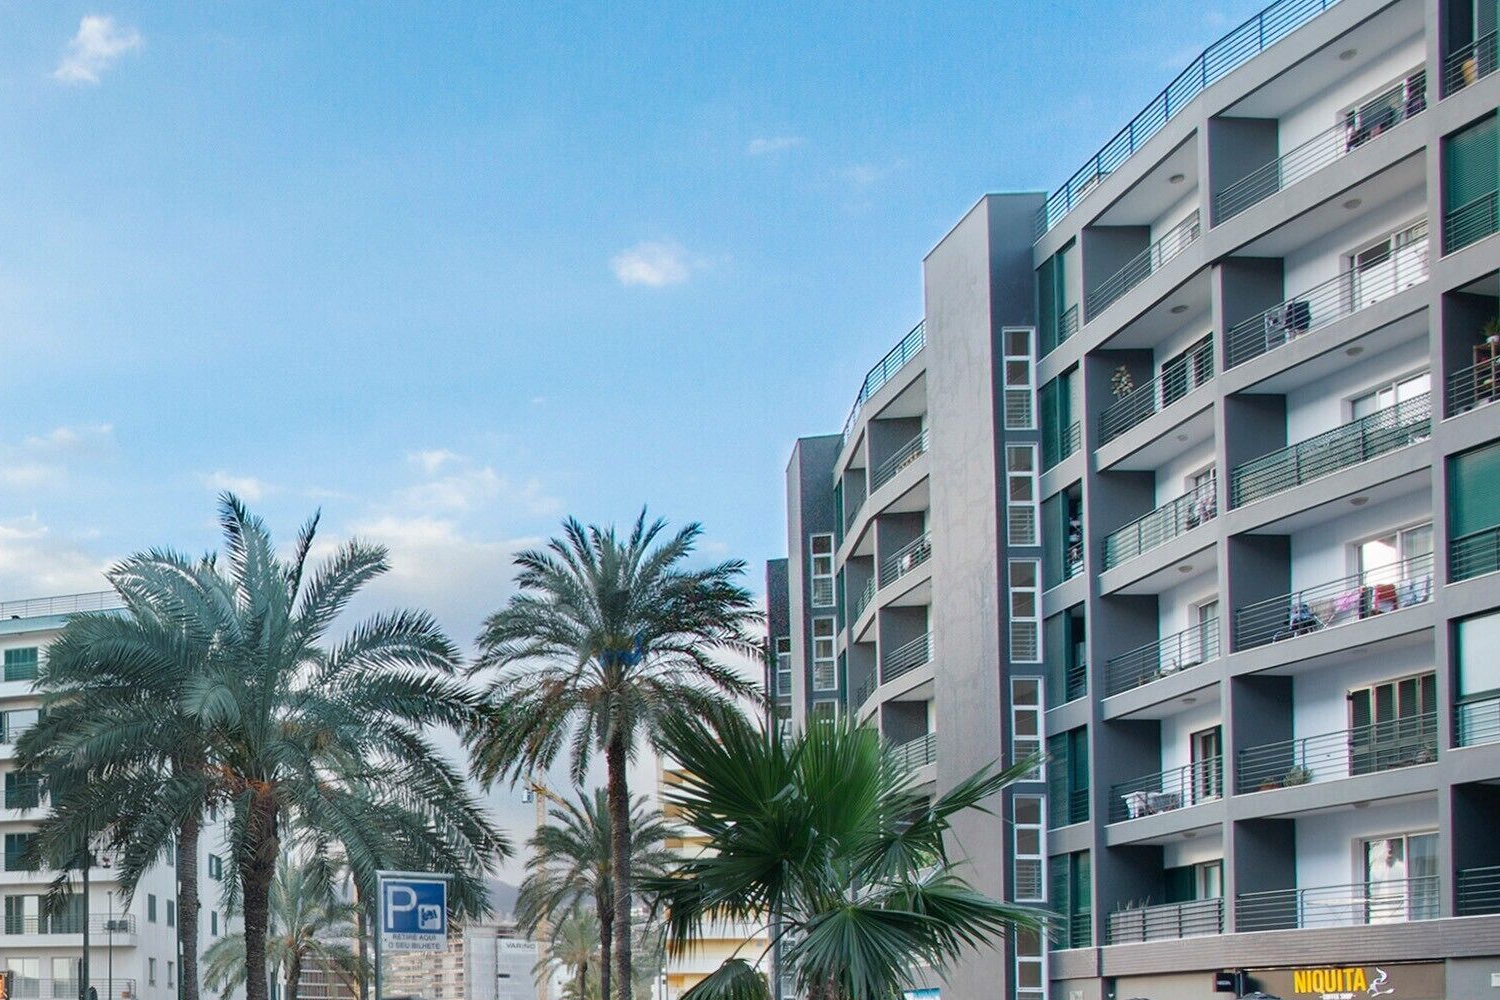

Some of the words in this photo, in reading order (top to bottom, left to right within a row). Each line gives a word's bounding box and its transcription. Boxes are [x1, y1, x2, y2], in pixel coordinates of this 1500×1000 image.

[386, 885, 418, 929] P
[392, 933, 418, 941] RETIRE
[419, 933, 437, 941] AQUI
[396, 942, 410, 950] SEU
[411, 942, 441, 950] BILHETE
[1294, 967, 1368, 994] NIQUITA
